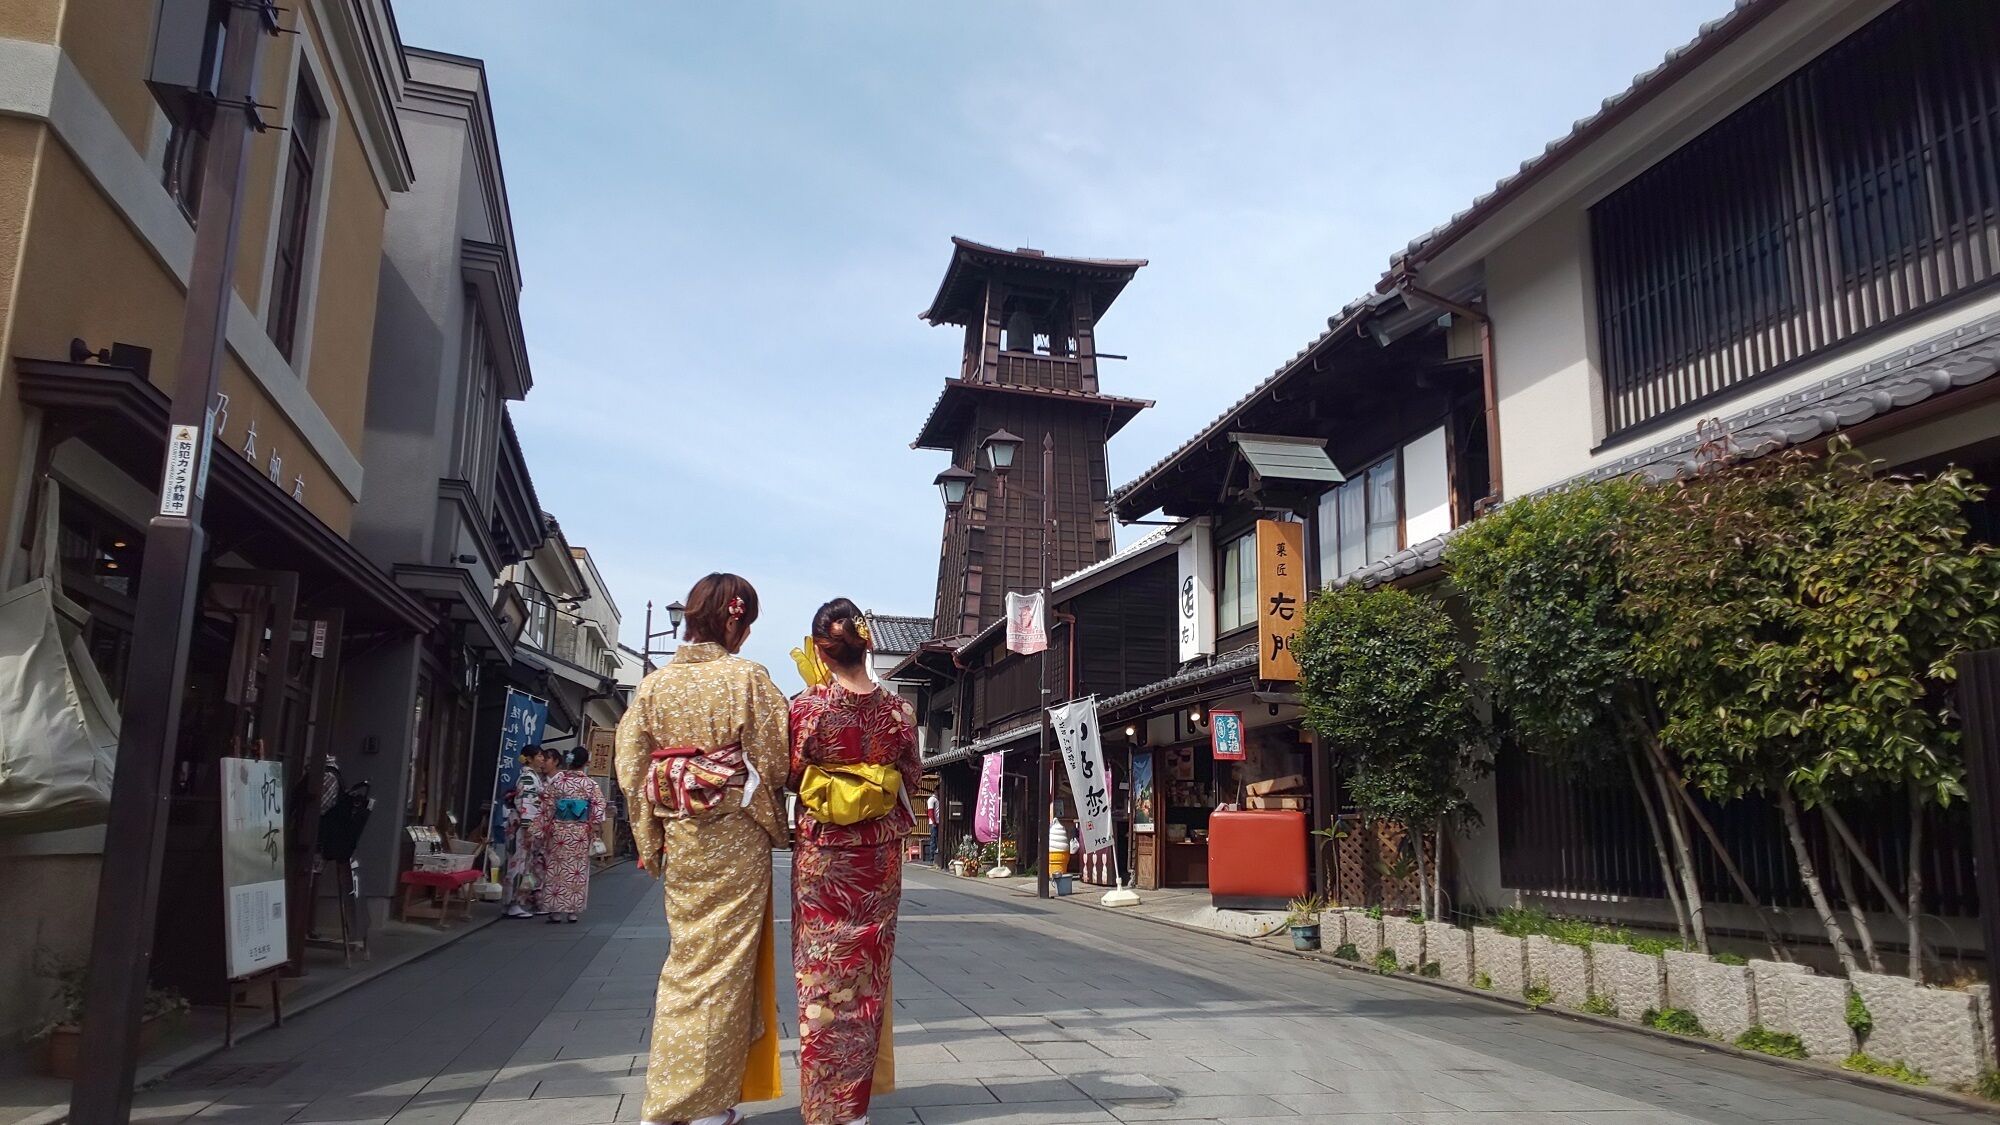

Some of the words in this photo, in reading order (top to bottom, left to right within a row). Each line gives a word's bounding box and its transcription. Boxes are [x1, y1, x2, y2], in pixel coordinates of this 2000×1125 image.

[172, 441, 192, 510] 防犯カメラ作動中
[1276, 543, 1288, 577] 菓匠
[1269, 592, 1299, 662] 右門
[1227, 717, 1240, 752] あま酒
[261, 773, 281, 870] 帆布
